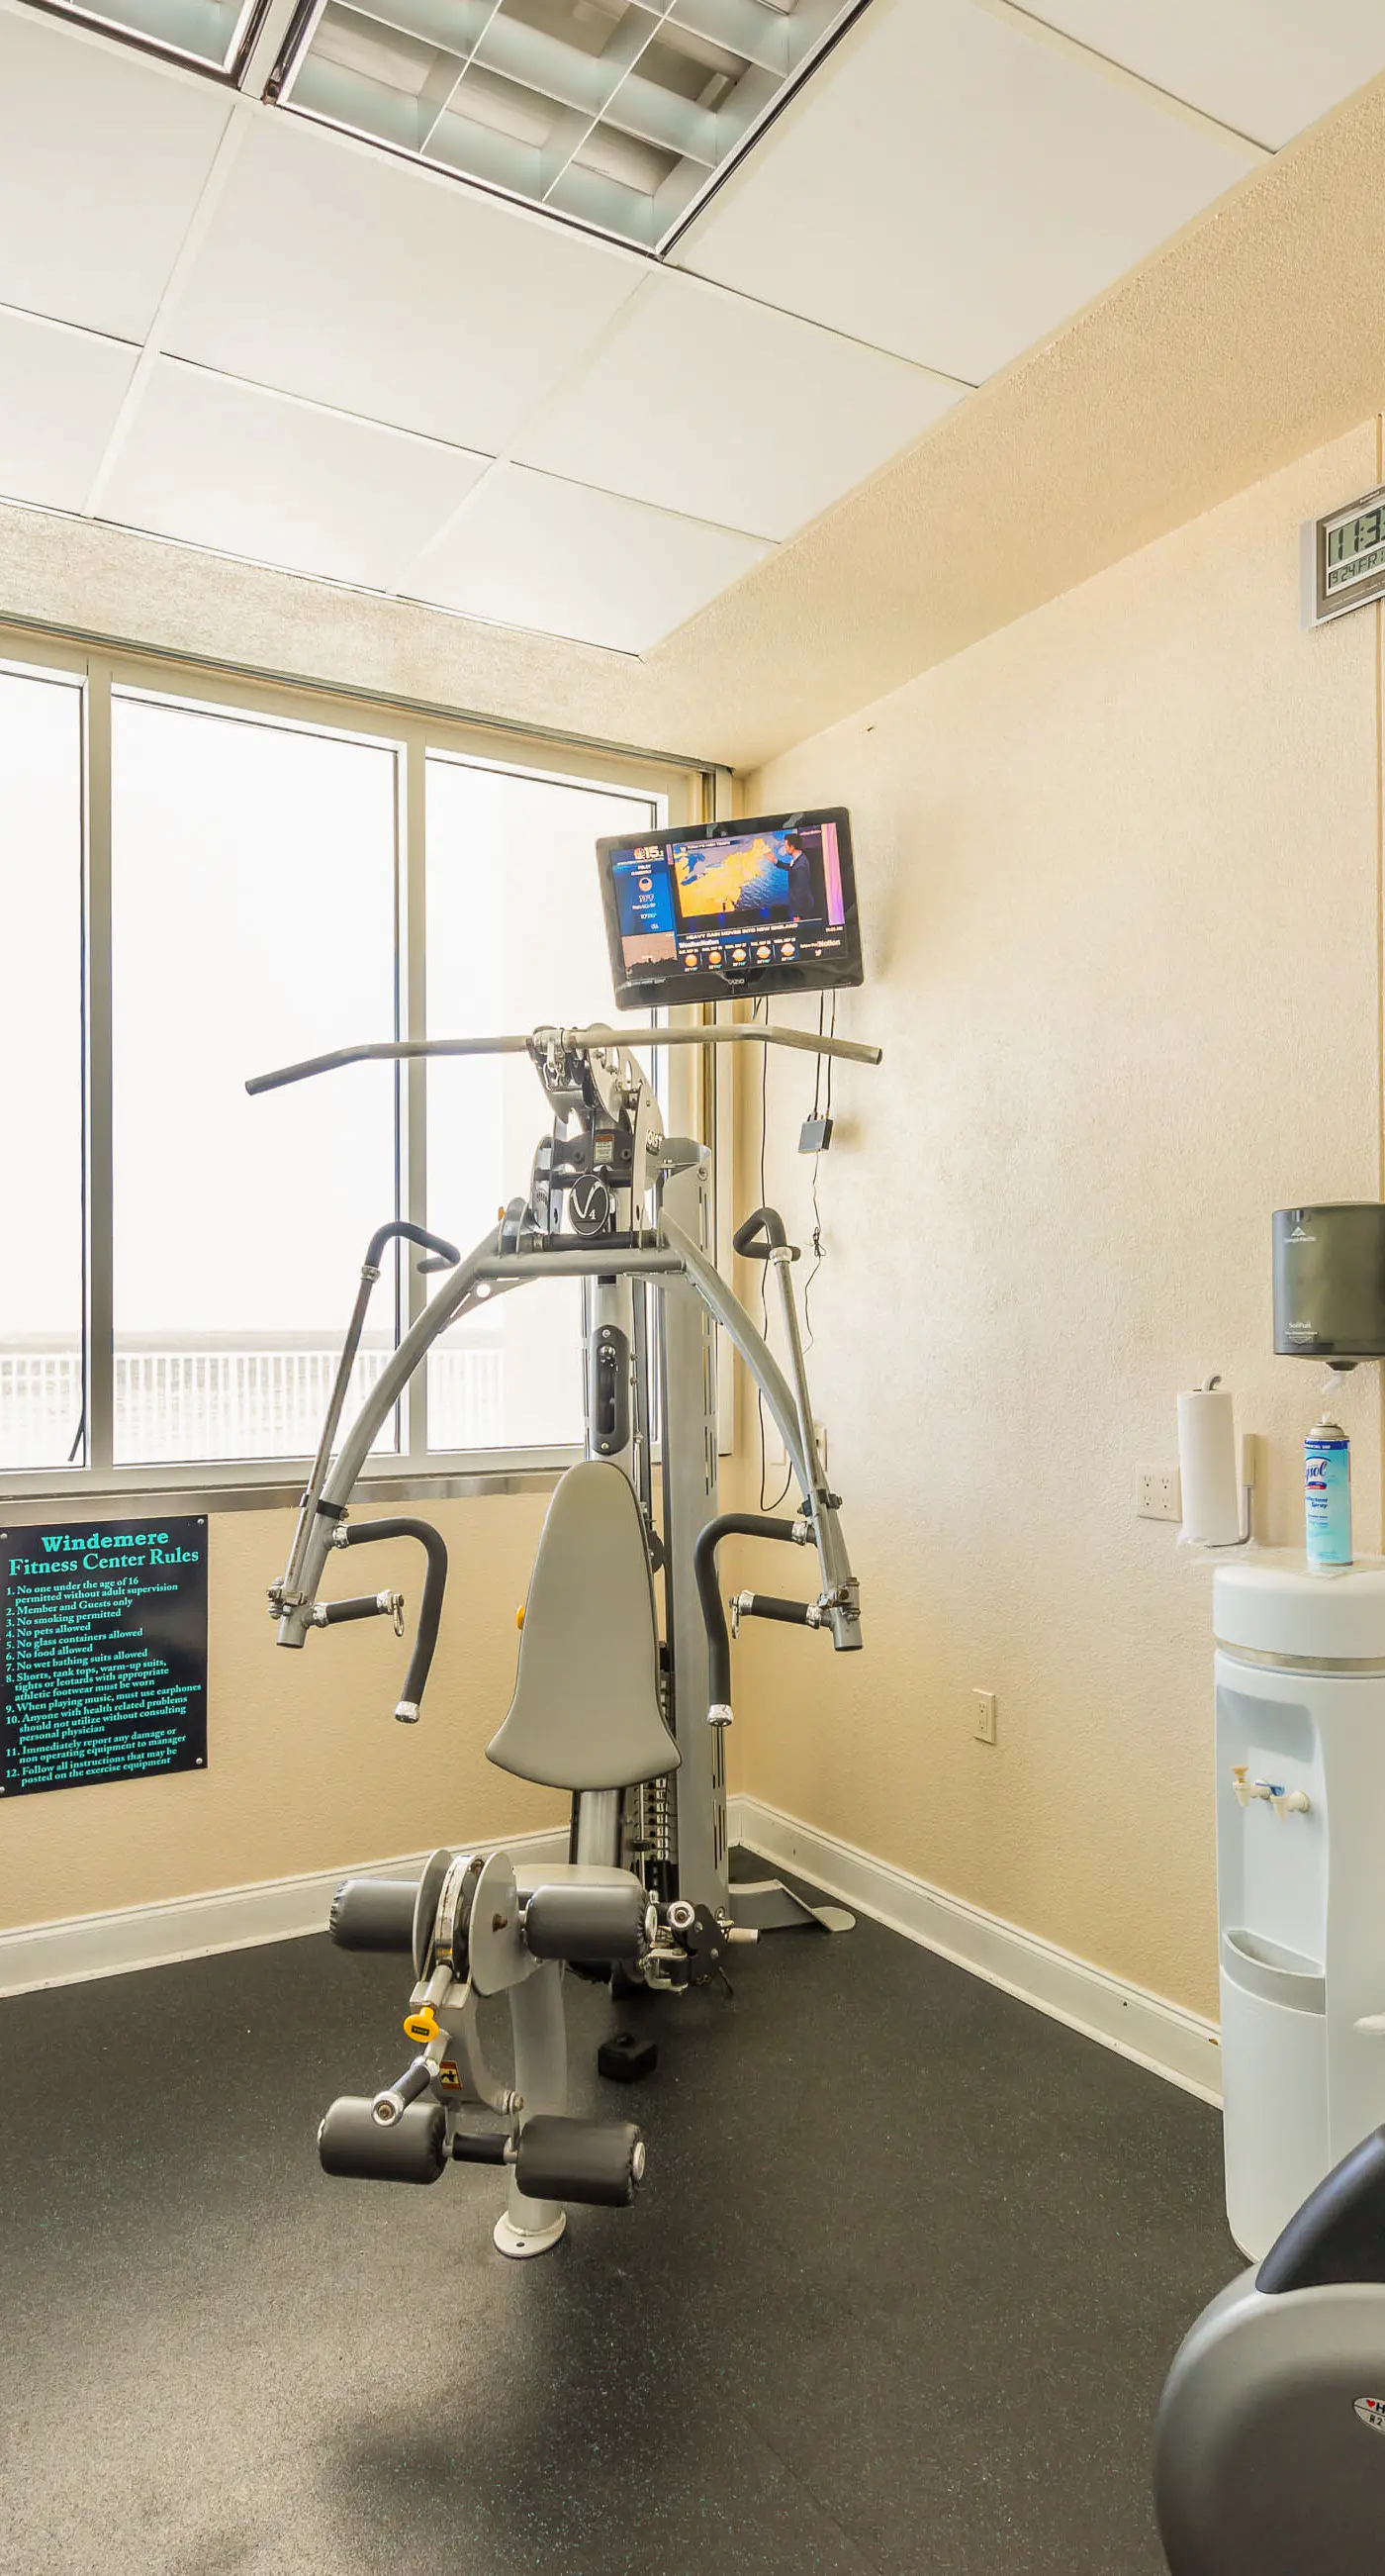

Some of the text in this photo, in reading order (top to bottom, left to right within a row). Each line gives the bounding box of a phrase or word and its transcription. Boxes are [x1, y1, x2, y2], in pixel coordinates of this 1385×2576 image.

[42, 1532, 169, 1552] Windemere
[9, 1547, 199, 1575] Fitness Center Rules
[15, 1583, 178, 1606] permitted without adult supervision
[17, 1585, 32, 1594] No
[53, 1582, 81, 1591] under
[100, 1581, 115, 1590] age
[117, 1577, 128, 1585] of
[128, 1576, 139, 1585] 16
[17, 1604, 57, 1615] Member
[59, 1602, 76, 1611] and
[79, 1601, 111, 1609] Guests
[113, 1597, 133, 1607] only
[6, 1609, 121, 1627] 3. No smoking permitted
[6, 1628, 143, 1649] 5. No glass containers allowed
[17, 1629, 32, 1637] No
[34, 1628, 53, 1638] pets
[55, 1622, 91, 1633] allowed
[17, 1651, 32, 1659] No
[34, 1648, 55, 1657] food
[57, 1644, 93, 1655] allowed
[17, 1662, 32, 1671] No
[53, 1657, 88, 1667] bathing
[91, 1654, 111, 1663] suits
[113, 1649, 148, 1660] allowed
[6, 1675, 14, 1683] 8.
[17, 1673, 51, 1682] Shorts,
[53, 1668, 74, 1678] tank
[76, 1668, 98, 1676] tops,
[100, 1662, 141, 1672] warm-up
[15, 1683, 42, 1692] tights
[56, 1676, 93, 1686] leotards
[95, 1672, 115, 1682] with
[118, 1668, 169, 1681] appropriate
[6, 1705, 14, 1713] 9.
[17, 1702, 46, 1712] When
[49, 1698, 83, 1711] playing
[85, 1694, 114, 1704] music,
[116, 1691, 138, 1700] must
[157, 1684, 201, 1696] earphones
[15, 1690, 50, 1701] athletic
[53, 1687, 93, 1697] footwear
[6, 1696, 187, 1724] 10. Anyone with health related problems
[20, 1721, 51, 1733] should
[71, 1717, 101, 1726] utilize
[103, 1712, 138, 1722] without
[139, 1706, 186, 1717] consulting
[6, 1748, 20, 1757] 11.
[22, 1740, 81, 1755] Immediately
[84, 1737, 112, 1748] report
[131, 1731, 165, 1740] damage
[19, 1725, 105, 1745] personal physician
[40, 1749, 84, 1763] operating
[87, 1742, 135, 1756] equipment
[149, 1735, 186, 1745] manager
[6, 1769, 20, 1778] 12.
[22, 1765, 54, 1776] Follow
[56, 1762, 68, 1771] all
[70, 1755, 125, 1769] instructions
[127, 1752, 145, 1761] that
[147, 1750, 165, 1759] may
[21, 1772, 52, 1787] posted
[69, 1769, 83, 1778] the
[86, 1765, 121, 1775] exercise
[123, 1757, 171, 1771] equipment
